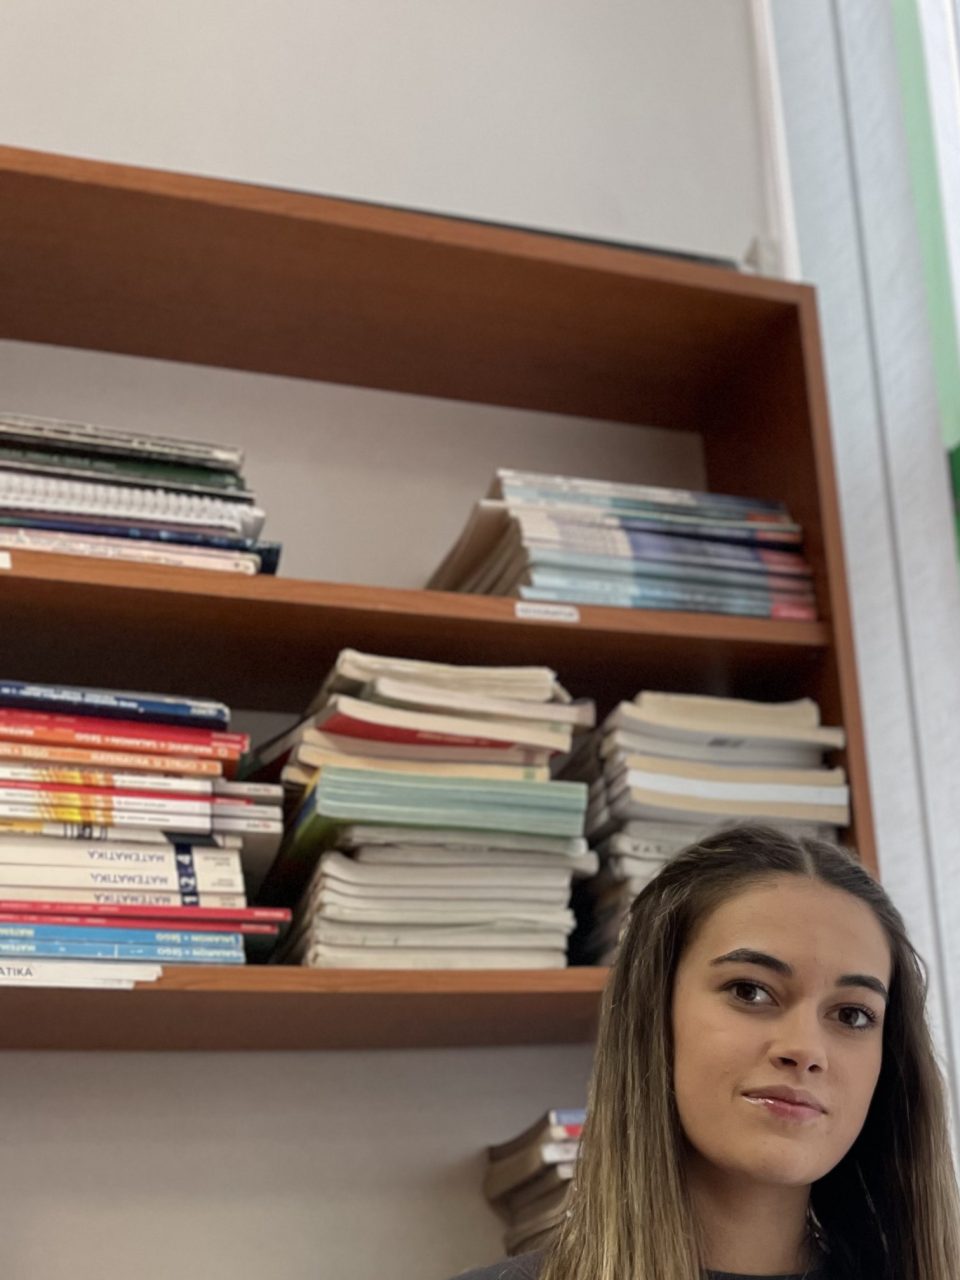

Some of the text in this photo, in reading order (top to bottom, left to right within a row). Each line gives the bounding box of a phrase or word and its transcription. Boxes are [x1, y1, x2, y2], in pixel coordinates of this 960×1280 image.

[87, 850, 165, 862] MATEMATIKA
[90, 872, 168, 885] MATEMATIKA
[94, 893, 171, 905] MATEMATIKA
